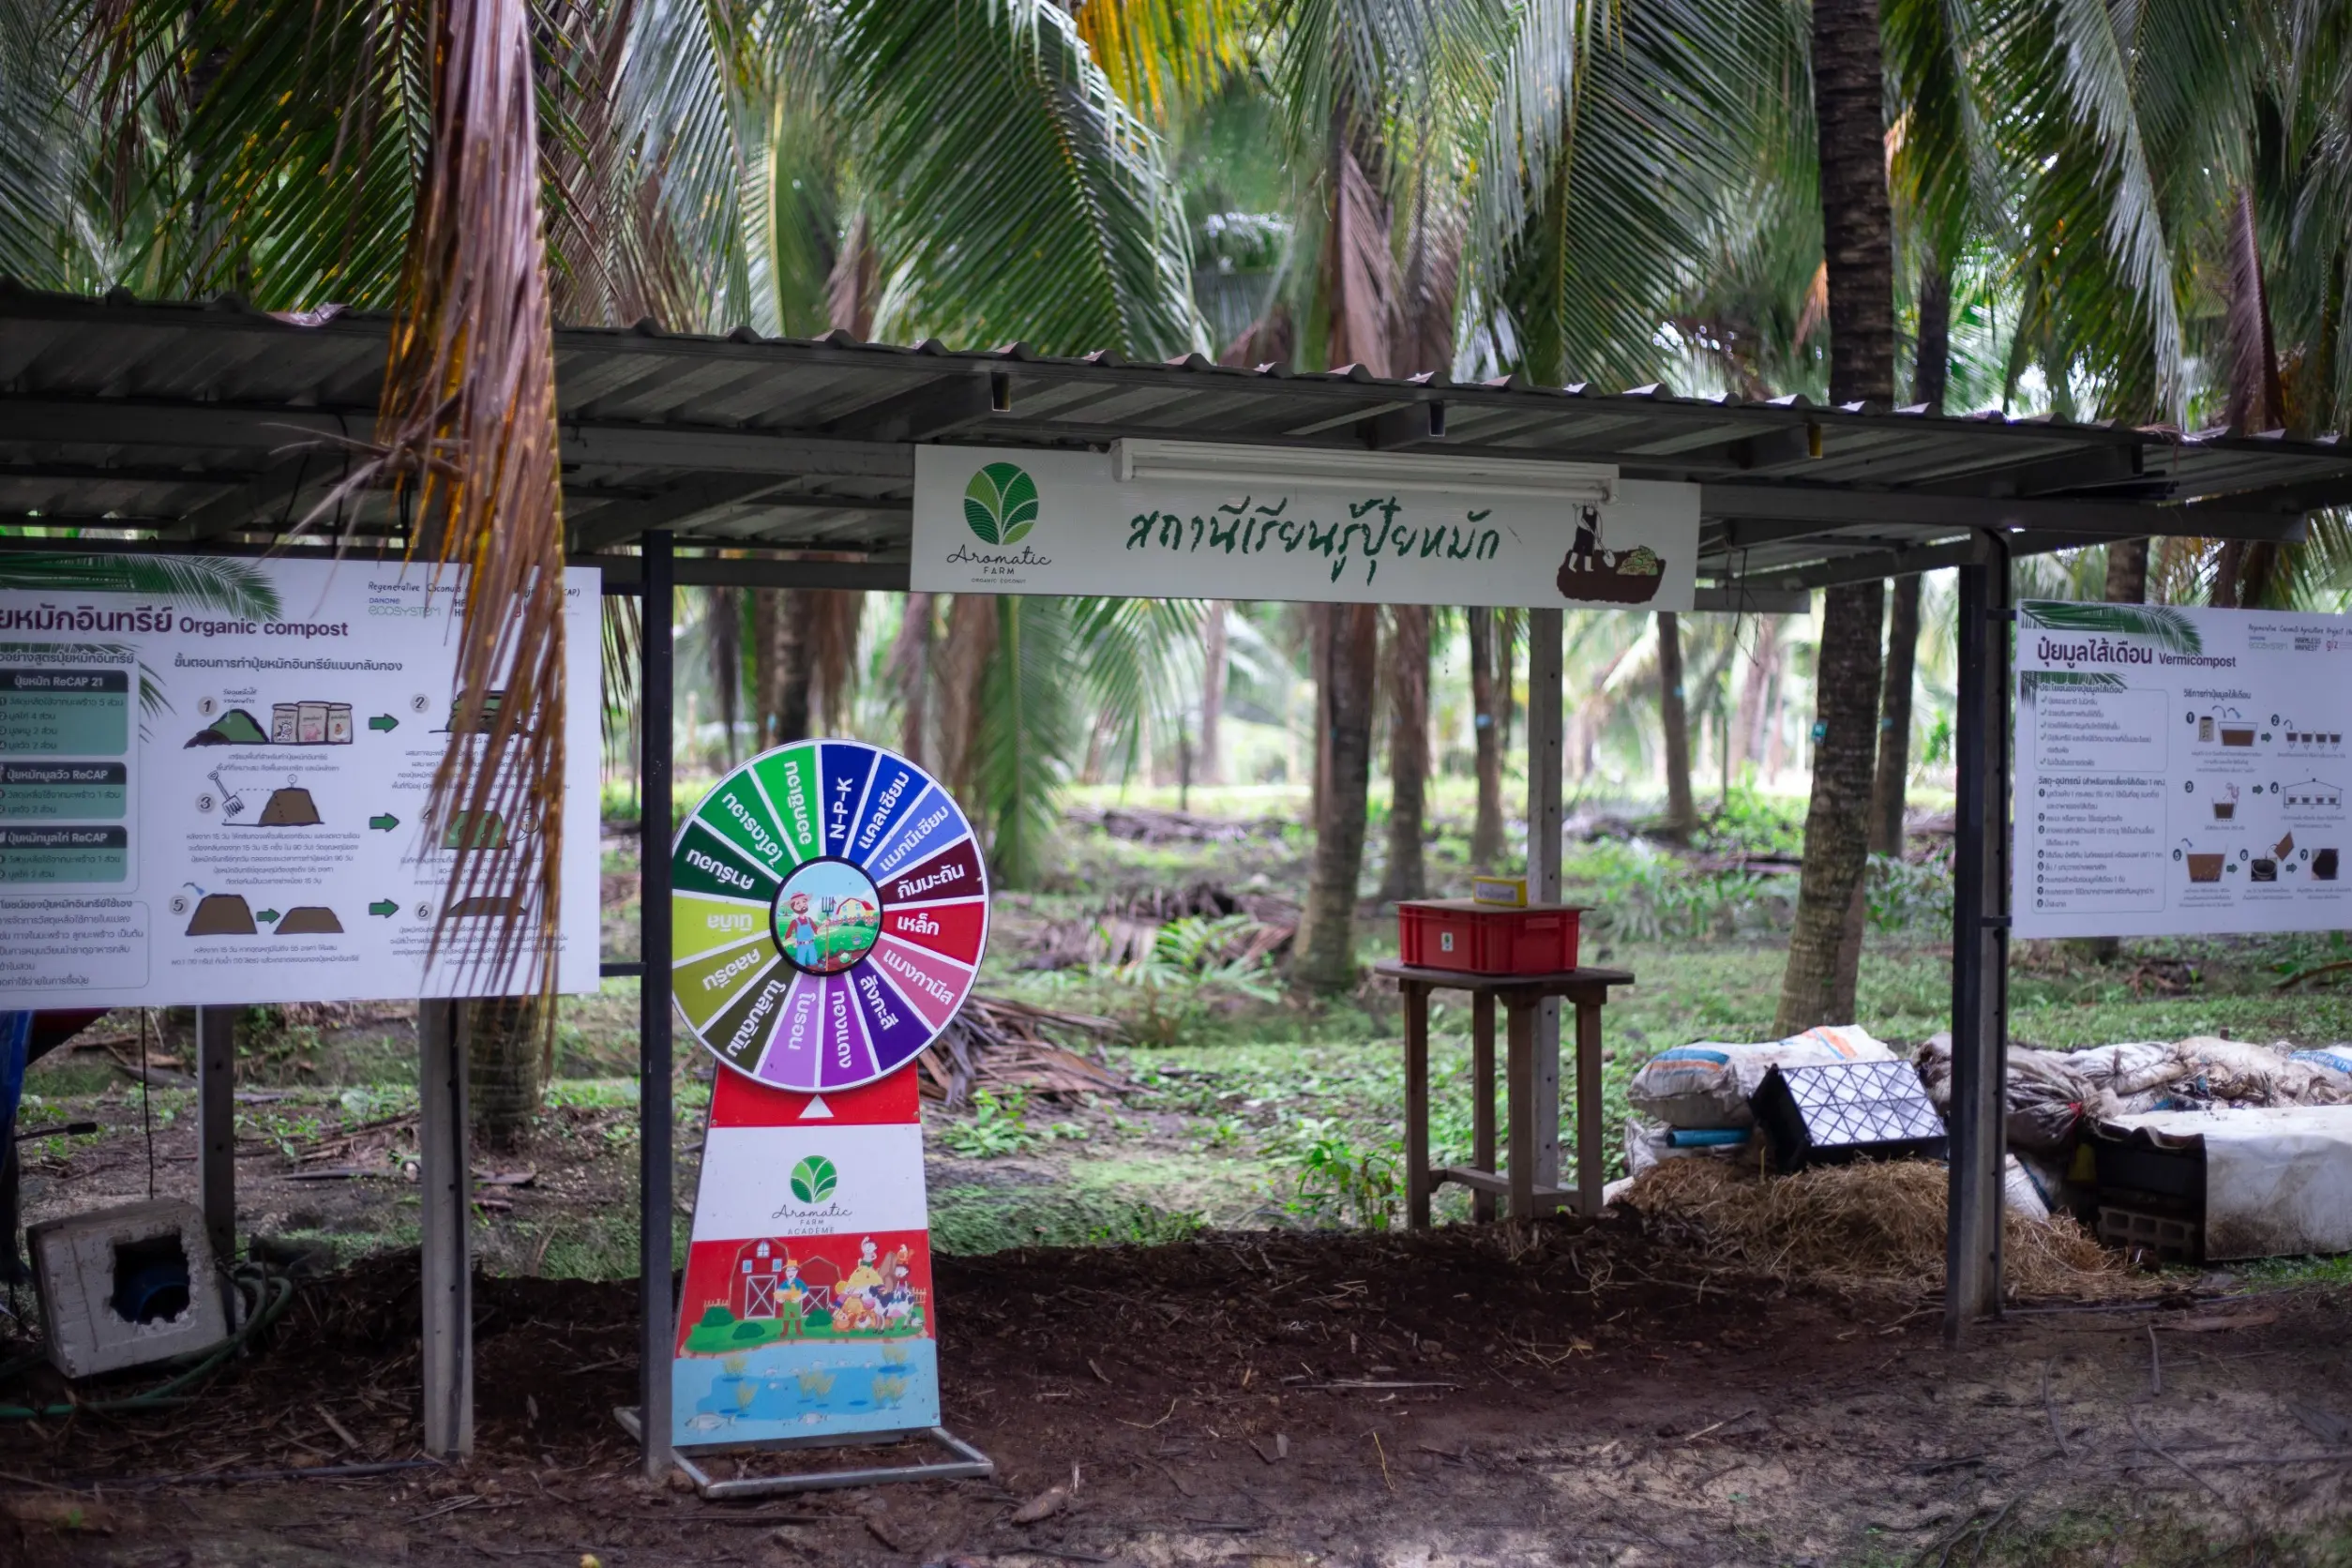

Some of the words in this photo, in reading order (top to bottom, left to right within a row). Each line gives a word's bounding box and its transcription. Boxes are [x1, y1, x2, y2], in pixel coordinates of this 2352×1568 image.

[1126, 495, 1500, 586] สถานีเรียนรู้ปุ๋ยหมัก
[946, 543, 1052, 565] Aromatic
[983, 566, 1015, 575] FARM
[368, 581, 420, 595] Regenerative
[179, 617, 256, 637] Organic
[264, 621, 348, 639] compost
[2037, 636, 2153, 669] ปุ๋ยมูลไส้เดือน
[2159, 652, 2237, 670] Vermicompost
[53, 677, 87, 686] ReCAP
[91, 677, 103, 686] 21
[203, 699, 213, 714] 1
[414, 695, 427, 710] 2
[72, 771, 108, 779] ReCAP
[200, 796, 211, 809] 3
[784, 761, 812, 845] ออกซิเจน
[829, 776, 853, 840] N-P-K
[857, 771, 911, 852] แคลเซียม
[71, 833, 108, 842] ReCAP
[722, 792, 784, 868] ไฮโดรเจน
[879, 805, 950, 873] แมกนีเซียม
[686, 849, 755, 890] คาร์บอน
[897, 863, 966, 899] กัมมะถัน
[173, 897, 184, 912] 5
[417, 904, 429, 918] 6
[706, 912, 753, 931] นิเกิล
[897, 912, 940, 936] เหล็ก
[702, 947, 761, 991] คลอรีน
[882, 949, 956, 1006] แมงกานีส
[859, 973, 899, 1032] สังกะสี
[788, 991, 817, 1051] โบรอน
[831, 990, 852, 1069] ทองแดง
[771, 1201, 852, 1219] Aromatic
